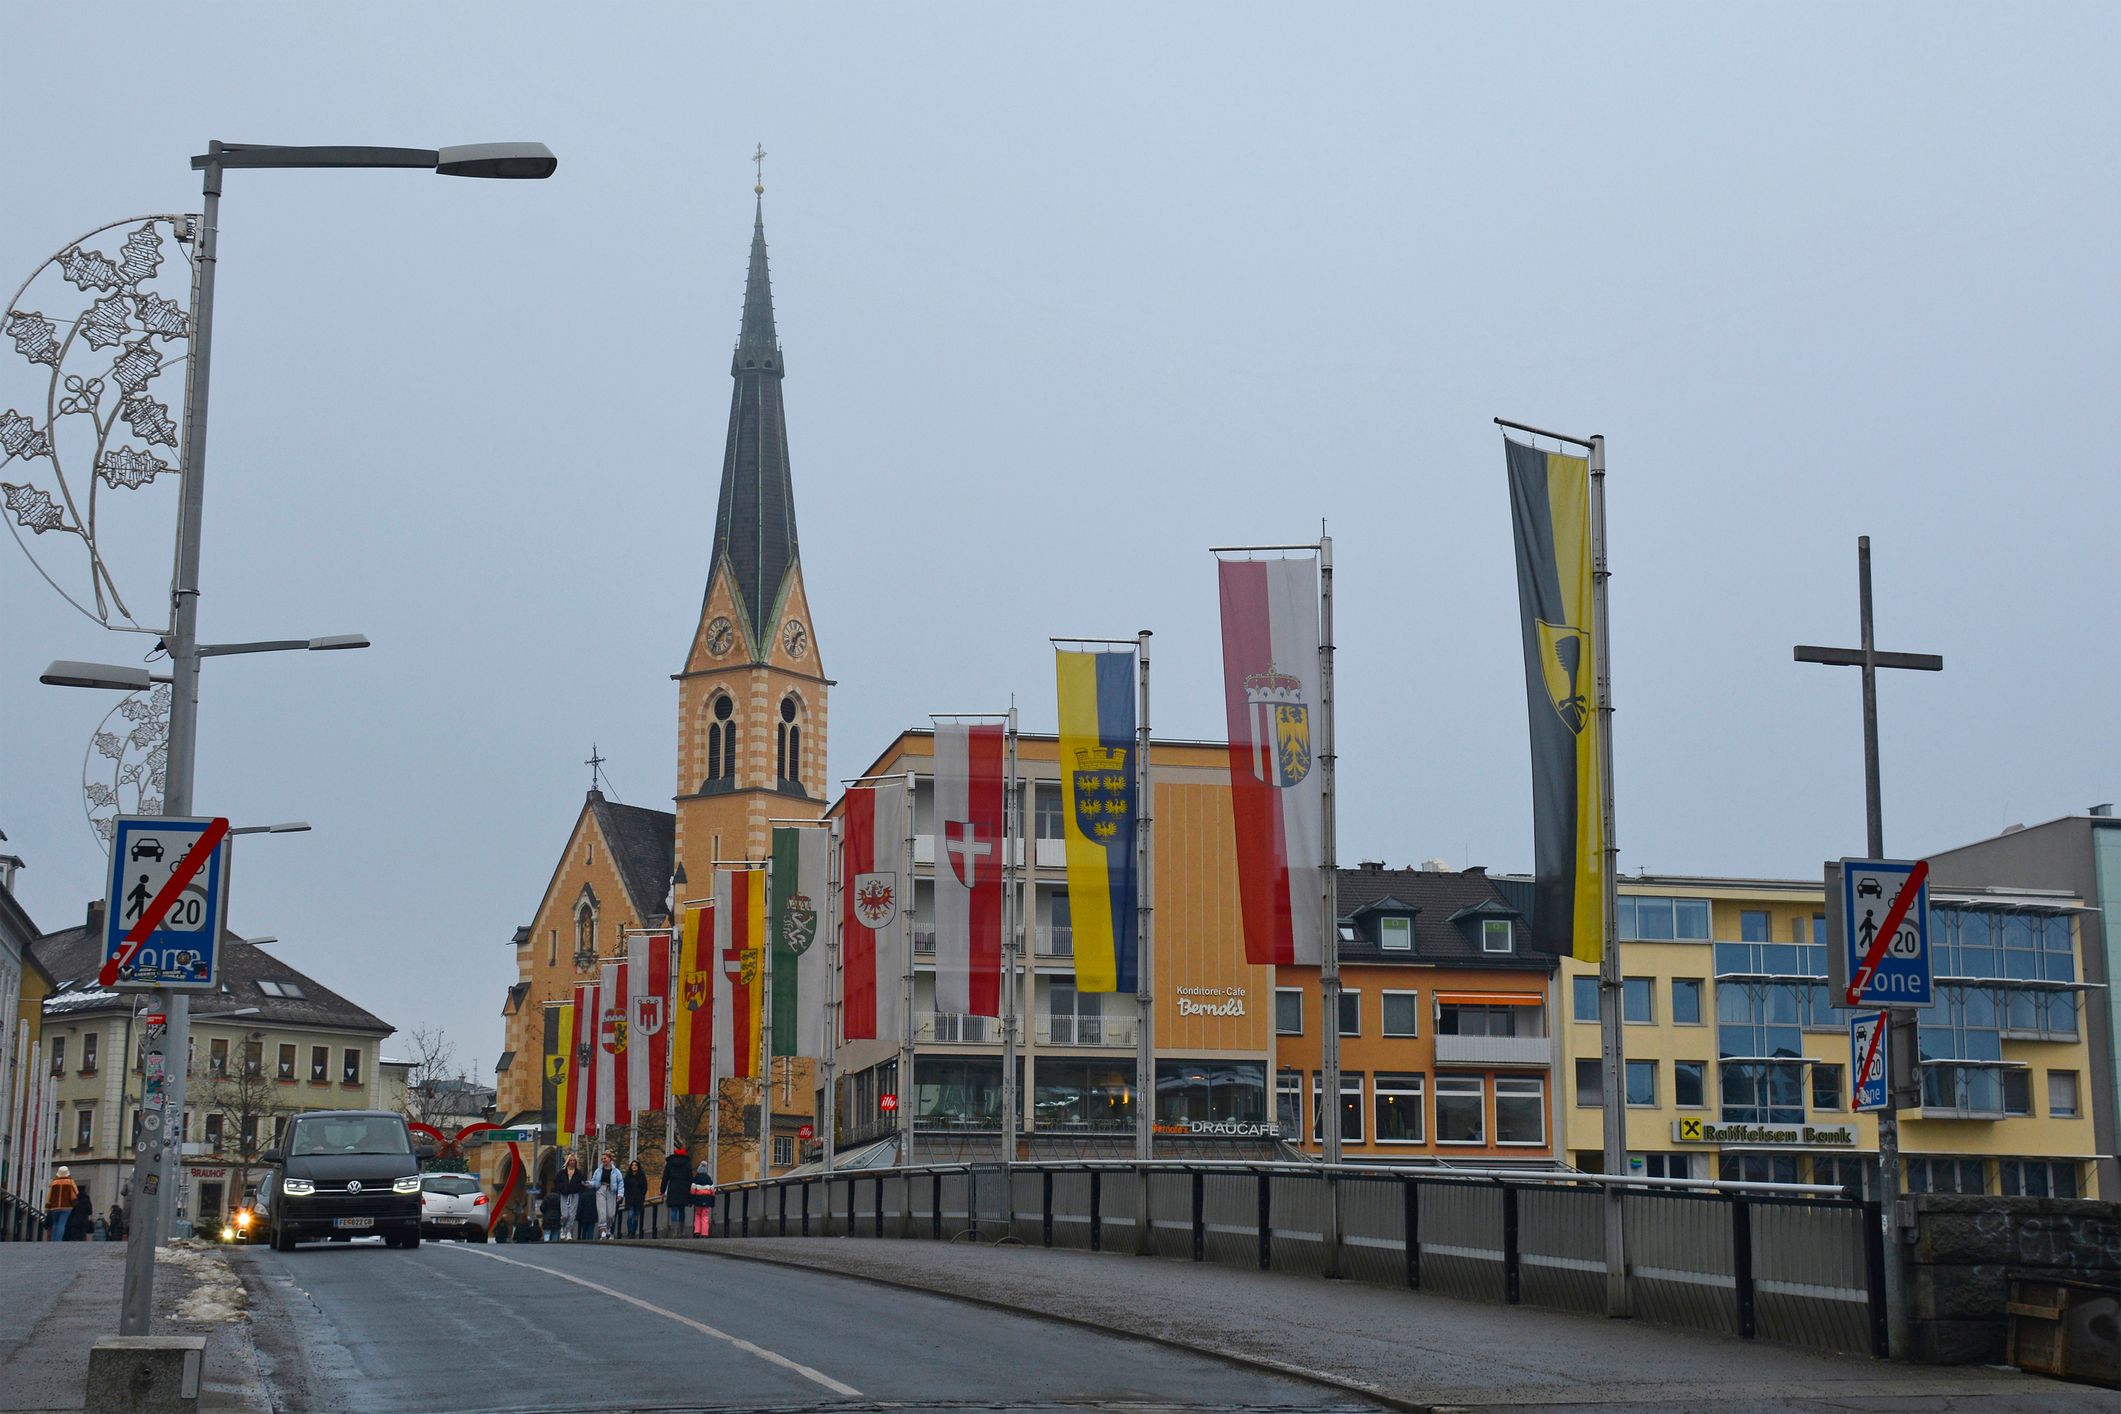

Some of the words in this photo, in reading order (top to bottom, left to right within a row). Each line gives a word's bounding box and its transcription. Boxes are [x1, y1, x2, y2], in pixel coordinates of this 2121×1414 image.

[170, 898, 201, 925] 20
[1893, 931, 1917, 953] 20
[1858, 966, 1921, 993] Zone
[1176, 997, 1246, 1016] Bernold
[1870, 1058, 1881, 1076] 20
[881, 1096, 896, 1109] illy
[800, 1127, 813, 1138] illy
[1703, 1125, 1798, 1142] Raiffeisen
[1803, 1127, 1852, 1143] Bank
[191, 1168, 227, 1178] BRAUHOF
